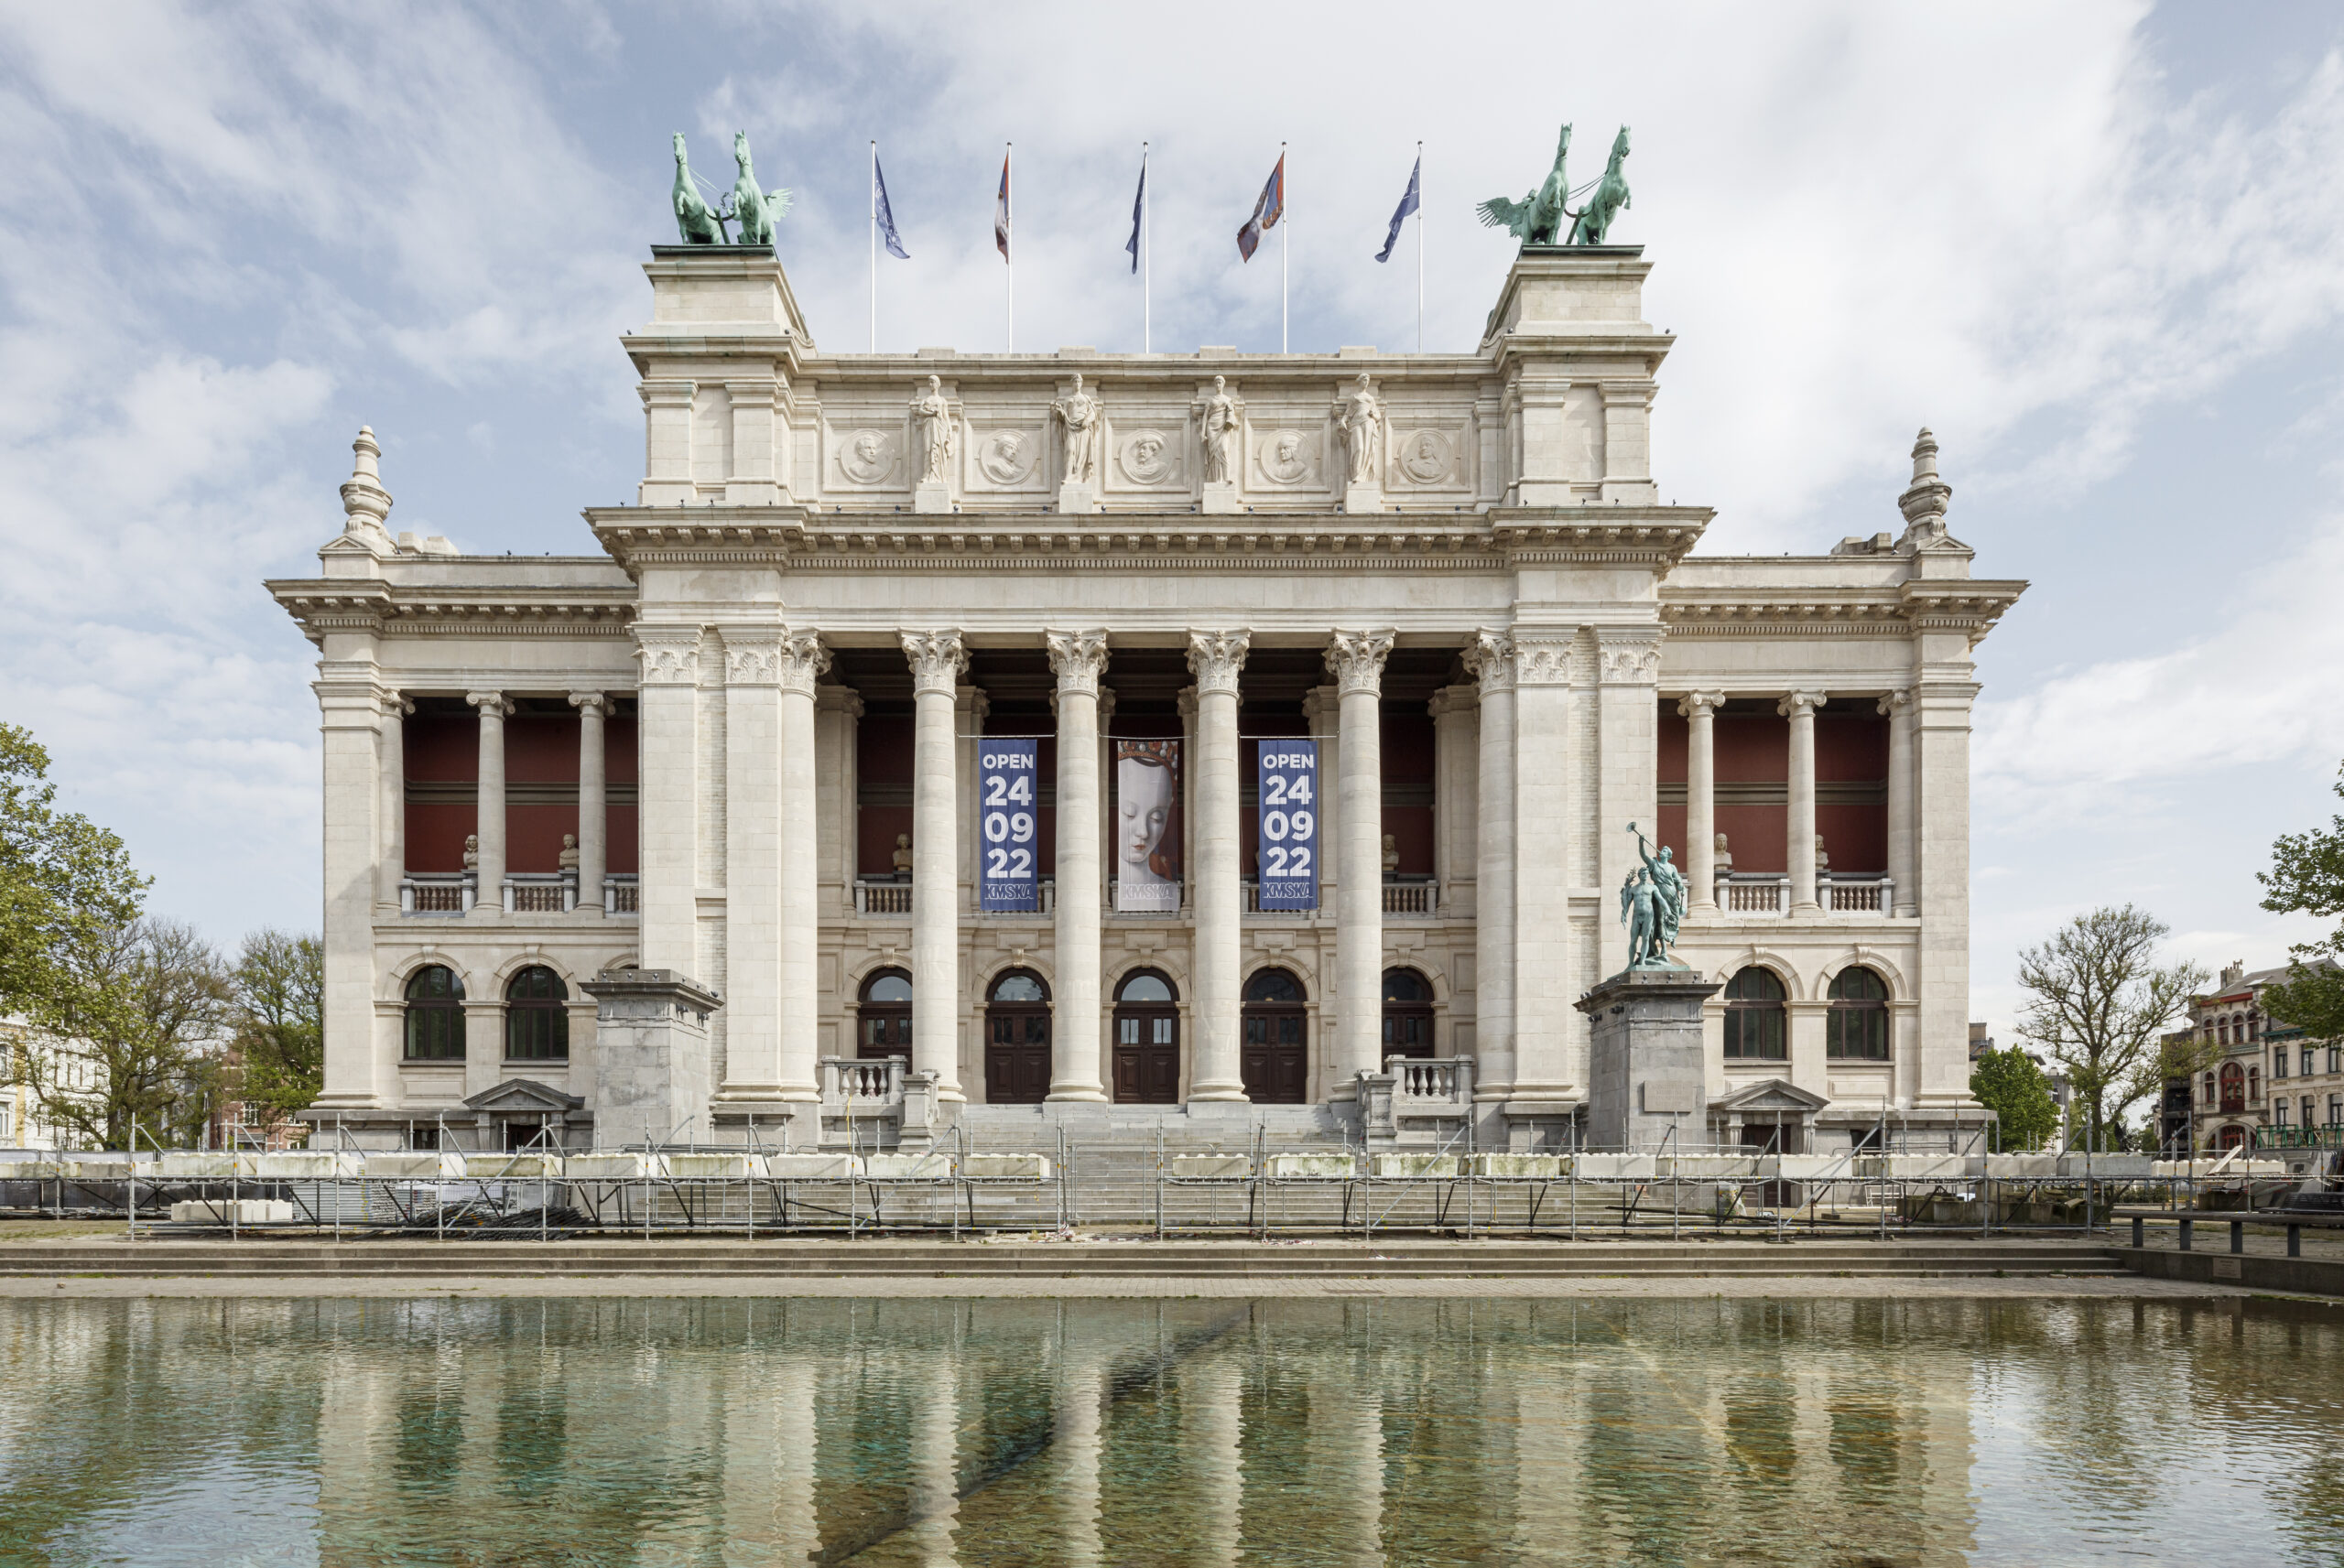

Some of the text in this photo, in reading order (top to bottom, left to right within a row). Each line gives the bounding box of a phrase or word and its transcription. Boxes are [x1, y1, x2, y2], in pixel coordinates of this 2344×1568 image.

[982, 753, 1034, 769] OPEN
[1263, 753, 1314, 769] OPEN
[985, 775, 1033, 806] 24
[1265, 774, 1313, 806] 24
[984, 811, 1034, 843] 09
[1264, 810, 1314, 841] 09
[987, 848, 1032, 879] 22
[1265, 846, 1311, 877] 22
[984, 883, 1034, 900] KMSKA
[1122, 883, 1173, 900] KMSKA
[1263, 881, 1314, 899] KMSKA
